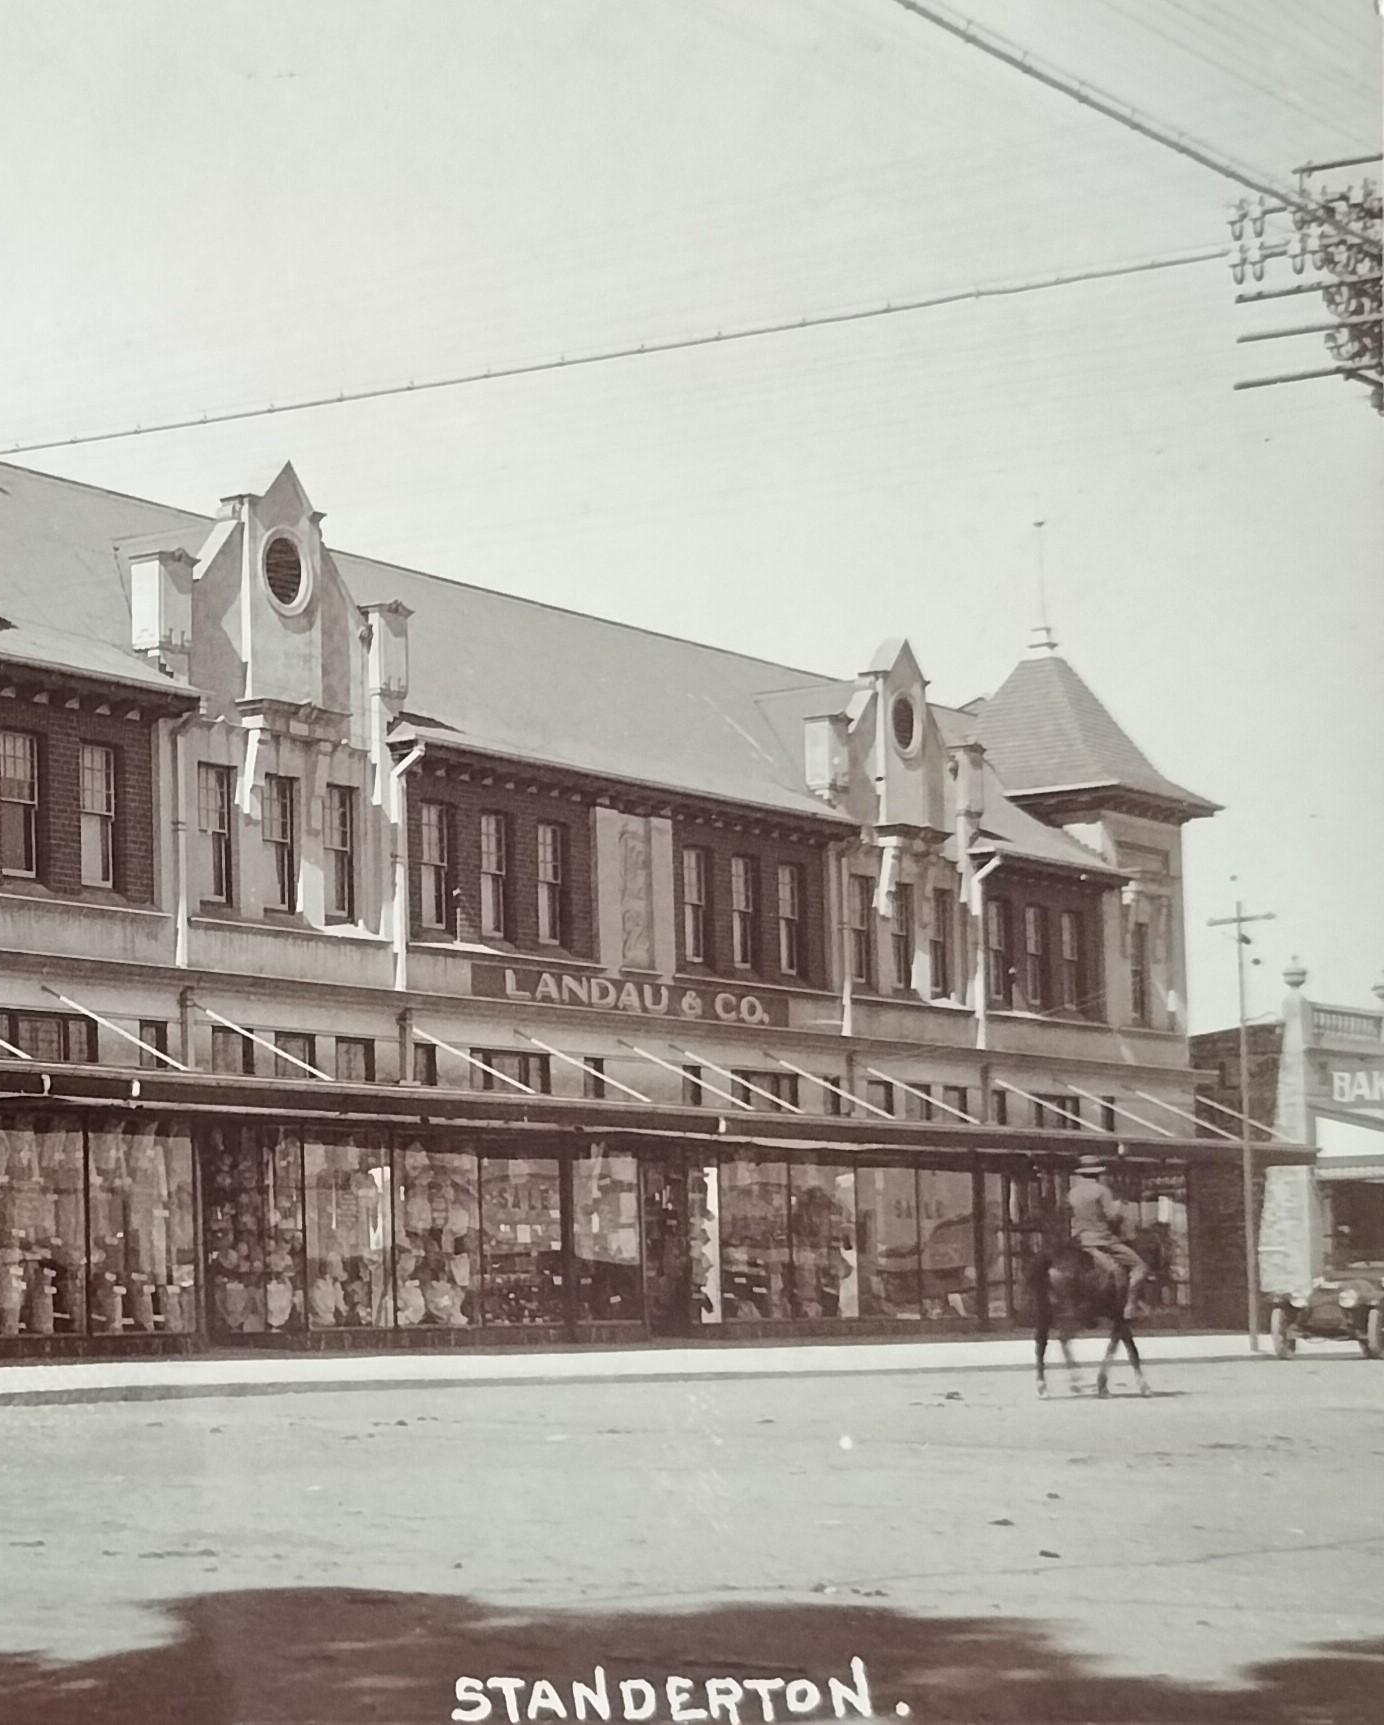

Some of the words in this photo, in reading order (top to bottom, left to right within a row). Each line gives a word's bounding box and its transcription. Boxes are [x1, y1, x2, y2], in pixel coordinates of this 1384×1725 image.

[504, 968, 669, 1015] LANDAU
[681, 991, 702, 1018] &
[715, 993, 770, 1025] CO.
